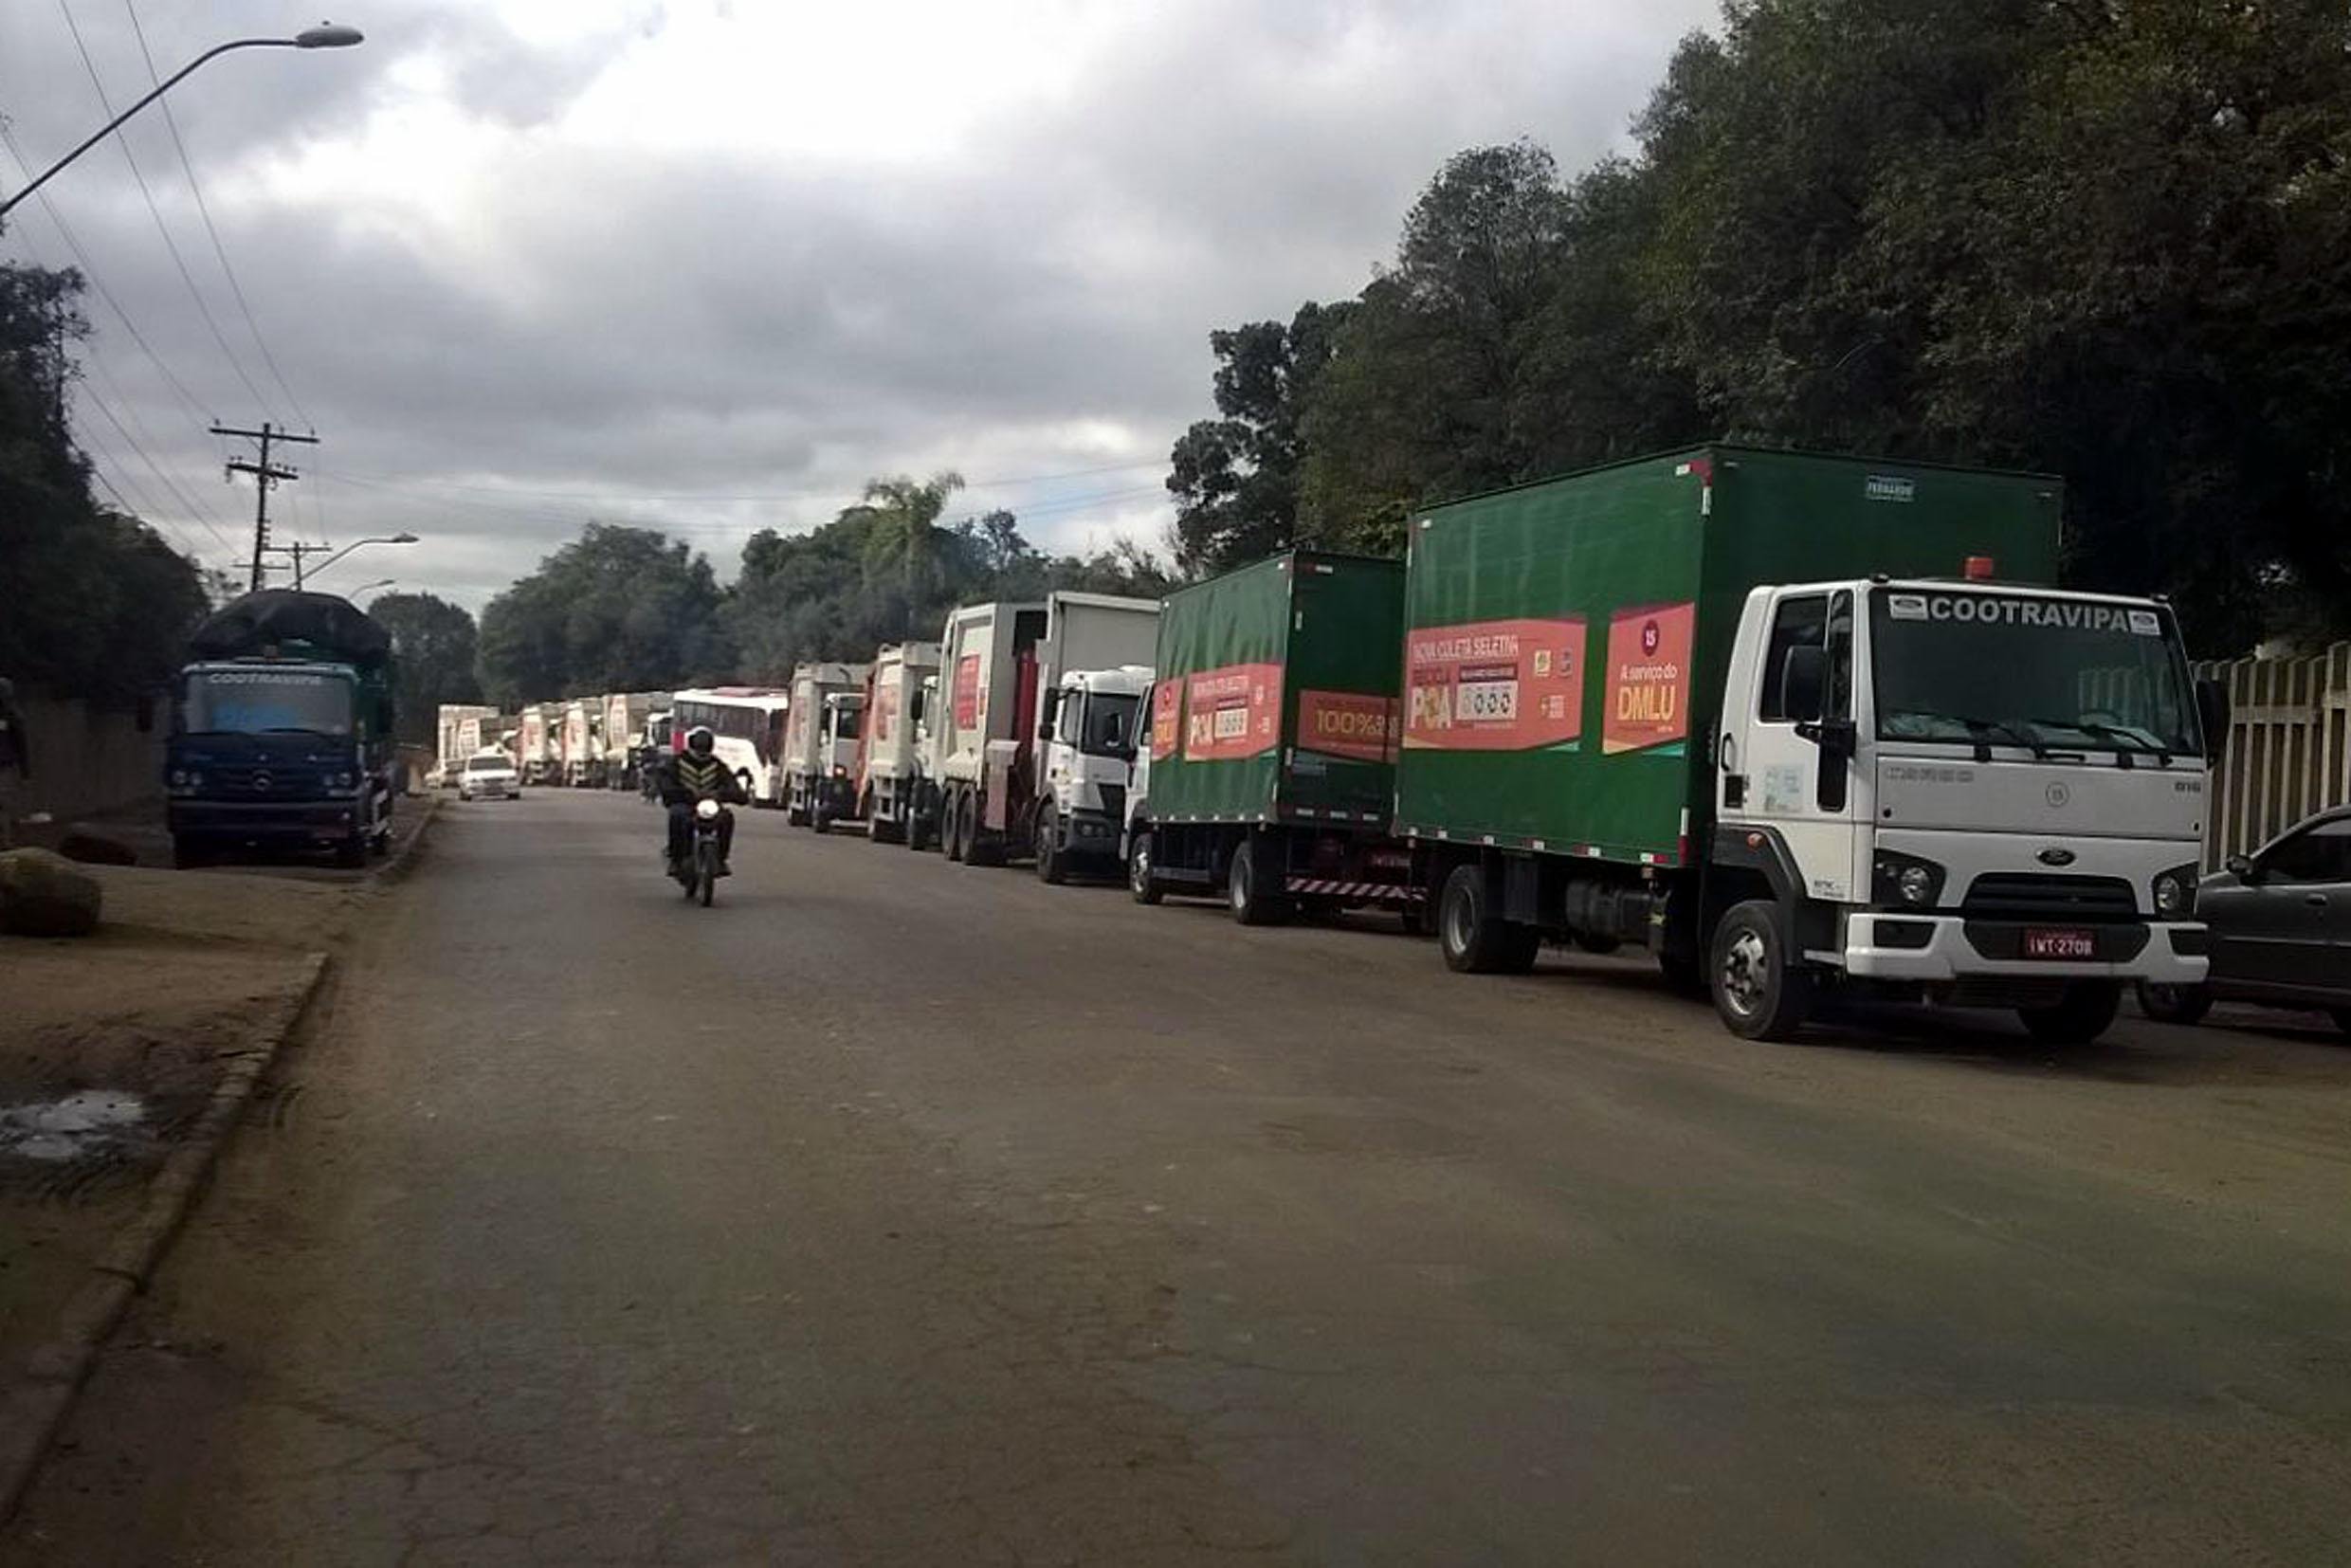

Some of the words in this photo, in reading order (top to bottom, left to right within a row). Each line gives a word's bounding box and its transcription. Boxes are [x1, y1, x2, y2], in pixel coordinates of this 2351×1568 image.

[1930, 596, 2128, 631] COOTRAVIPA
[1617, 684, 1675, 720] DMLU
[1316, 708, 1376, 736] 100%
